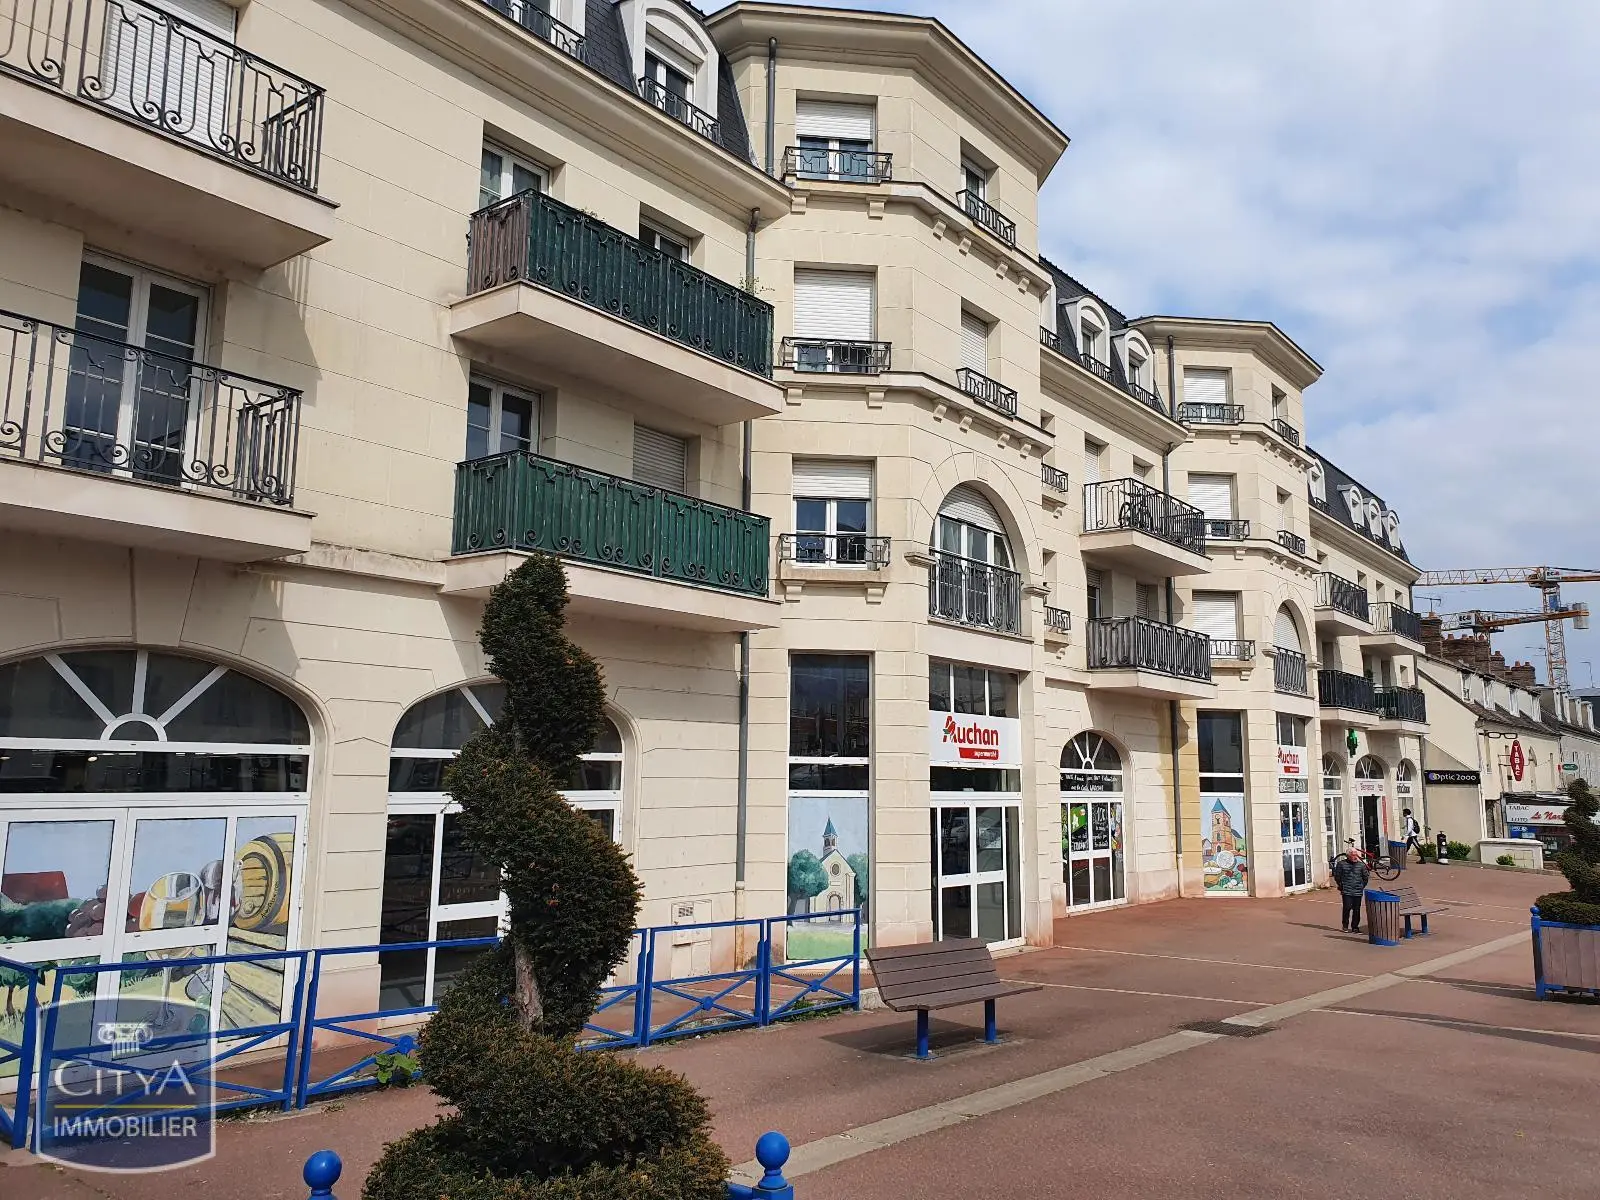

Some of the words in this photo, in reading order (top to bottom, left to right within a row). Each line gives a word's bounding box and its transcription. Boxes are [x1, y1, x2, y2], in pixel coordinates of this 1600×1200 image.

[942, 715, 999, 746] Auchan
[1277, 746, 1300, 764] Auchan
[1513, 745, 1521, 776] TABAC
[1432, 772, 1456, 782] Optic
[1456, 773, 1477, 781] 2000
[1530, 811, 1542, 820] Le
